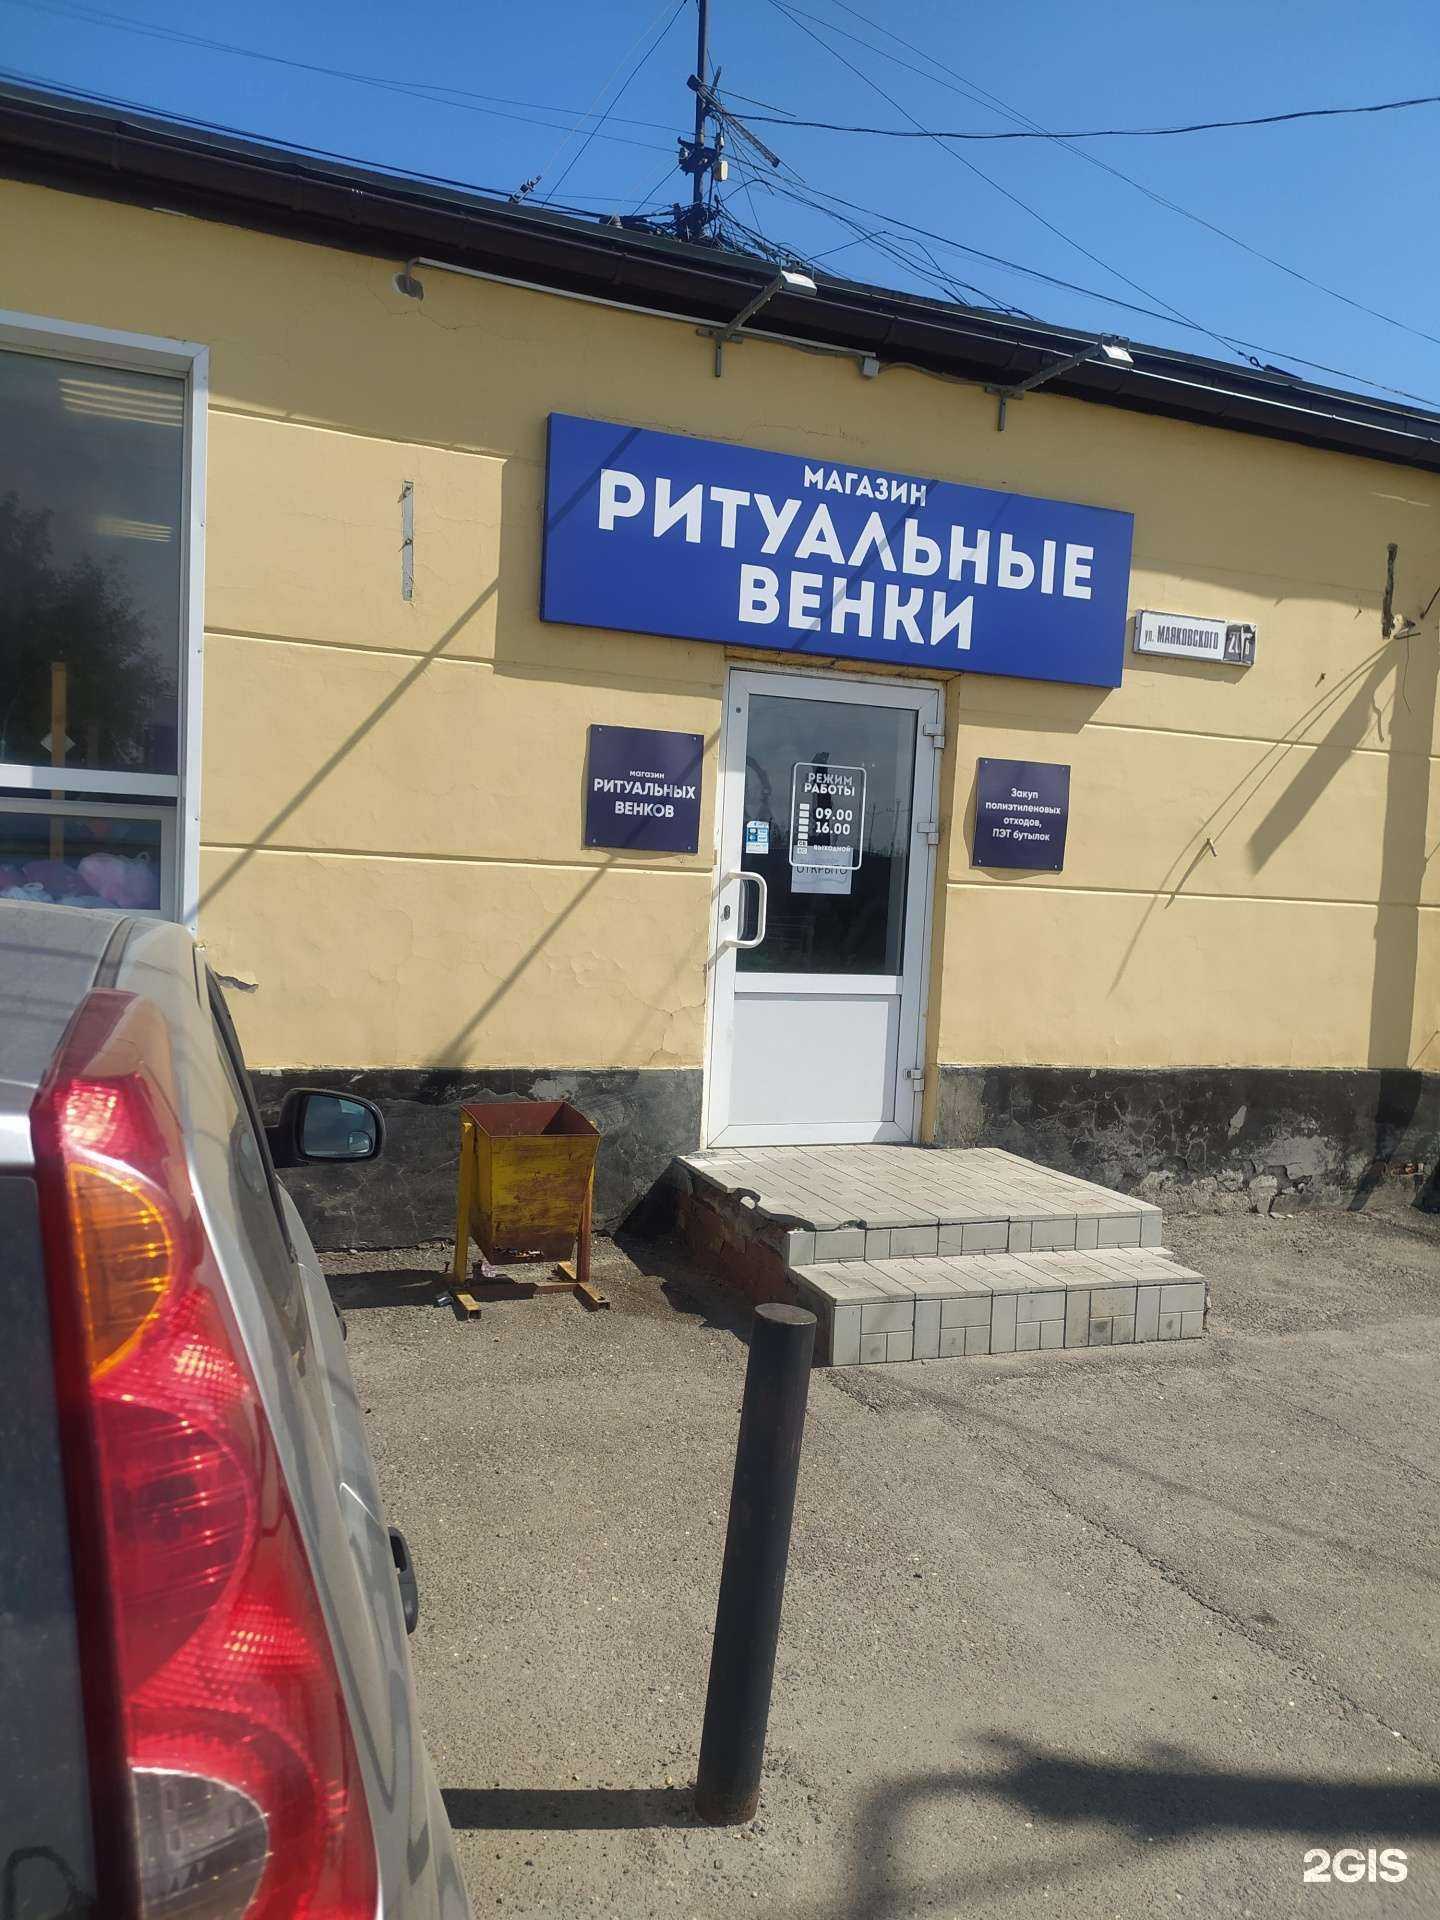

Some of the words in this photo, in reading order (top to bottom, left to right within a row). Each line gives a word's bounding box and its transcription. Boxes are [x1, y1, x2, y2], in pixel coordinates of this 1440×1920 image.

[804, 465, 926, 507] МАГАЗИН
[598, 468, 1095, 600] РИТУАЛЬНЫЕ
[738, 563, 974, 650] ВЕНКИ
[1144, 629, 1154, 644] ул.
[1157, 625, 1219, 650] МАЯКОВСКОГО
[629, 770, 665, 779] магазин
[808, 772, 853, 785] РЕЖИМ
[593, 778, 696, 799] РИТУАЛЬНЫХ
[804, 782, 855, 796] РАБОТЫ
[1011, 788, 1039, 800] Закуп
[614, 800, 675, 818] ВЕНКОВ
[985, 801, 1061, 814] полиэтиленовых
[815, 808, 853, 821] 09.00
[815, 821, 851, 834] 16.00
[1003, 817, 1042, 828] отходов,
[992, 828, 1011, 838] ПЭТ
[1013, 830, 1051, 841] бутылок
